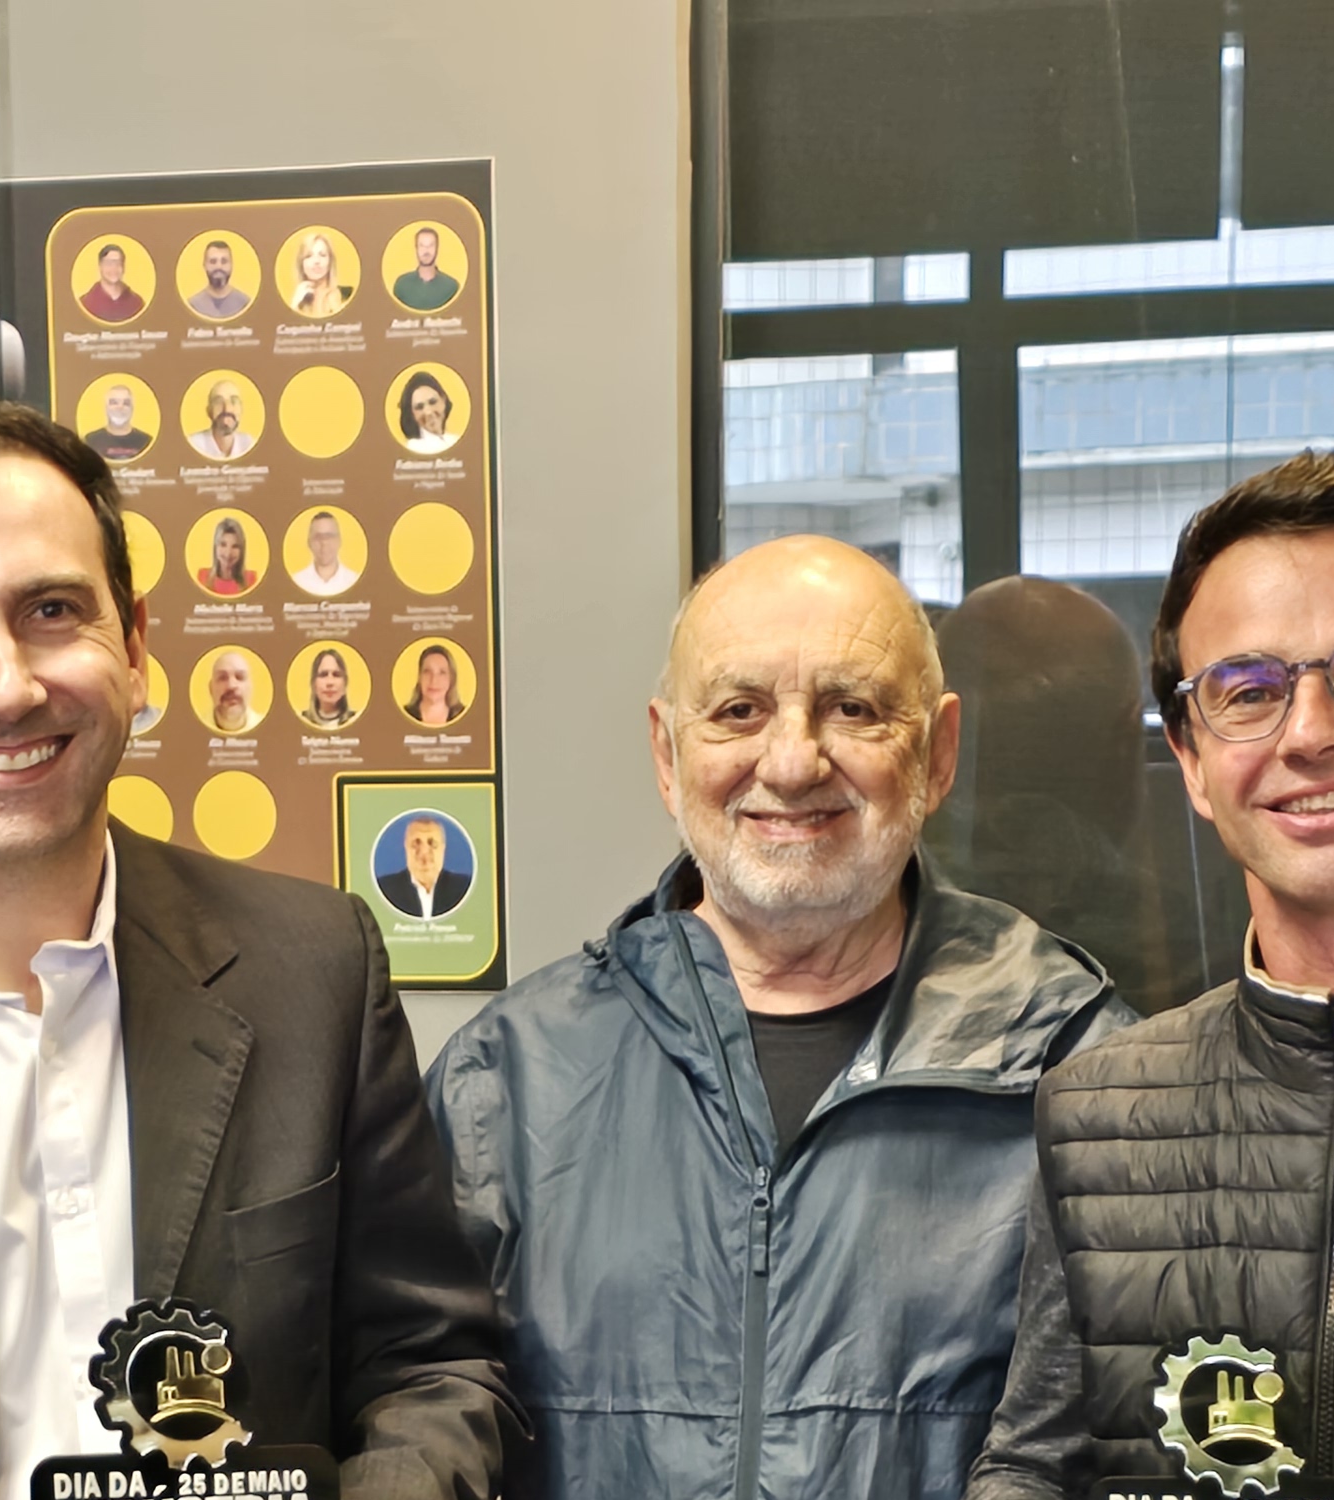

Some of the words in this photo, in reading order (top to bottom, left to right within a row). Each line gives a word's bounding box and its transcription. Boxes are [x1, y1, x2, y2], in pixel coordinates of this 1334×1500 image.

[53, 1471, 102, 1500] DIA
[108, 1470, 148, 1499] DA
[178, 1473, 207, 1495] 25
[213, 1472, 245, 1495] DE
[247, 1469, 308, 1493] MAIO
